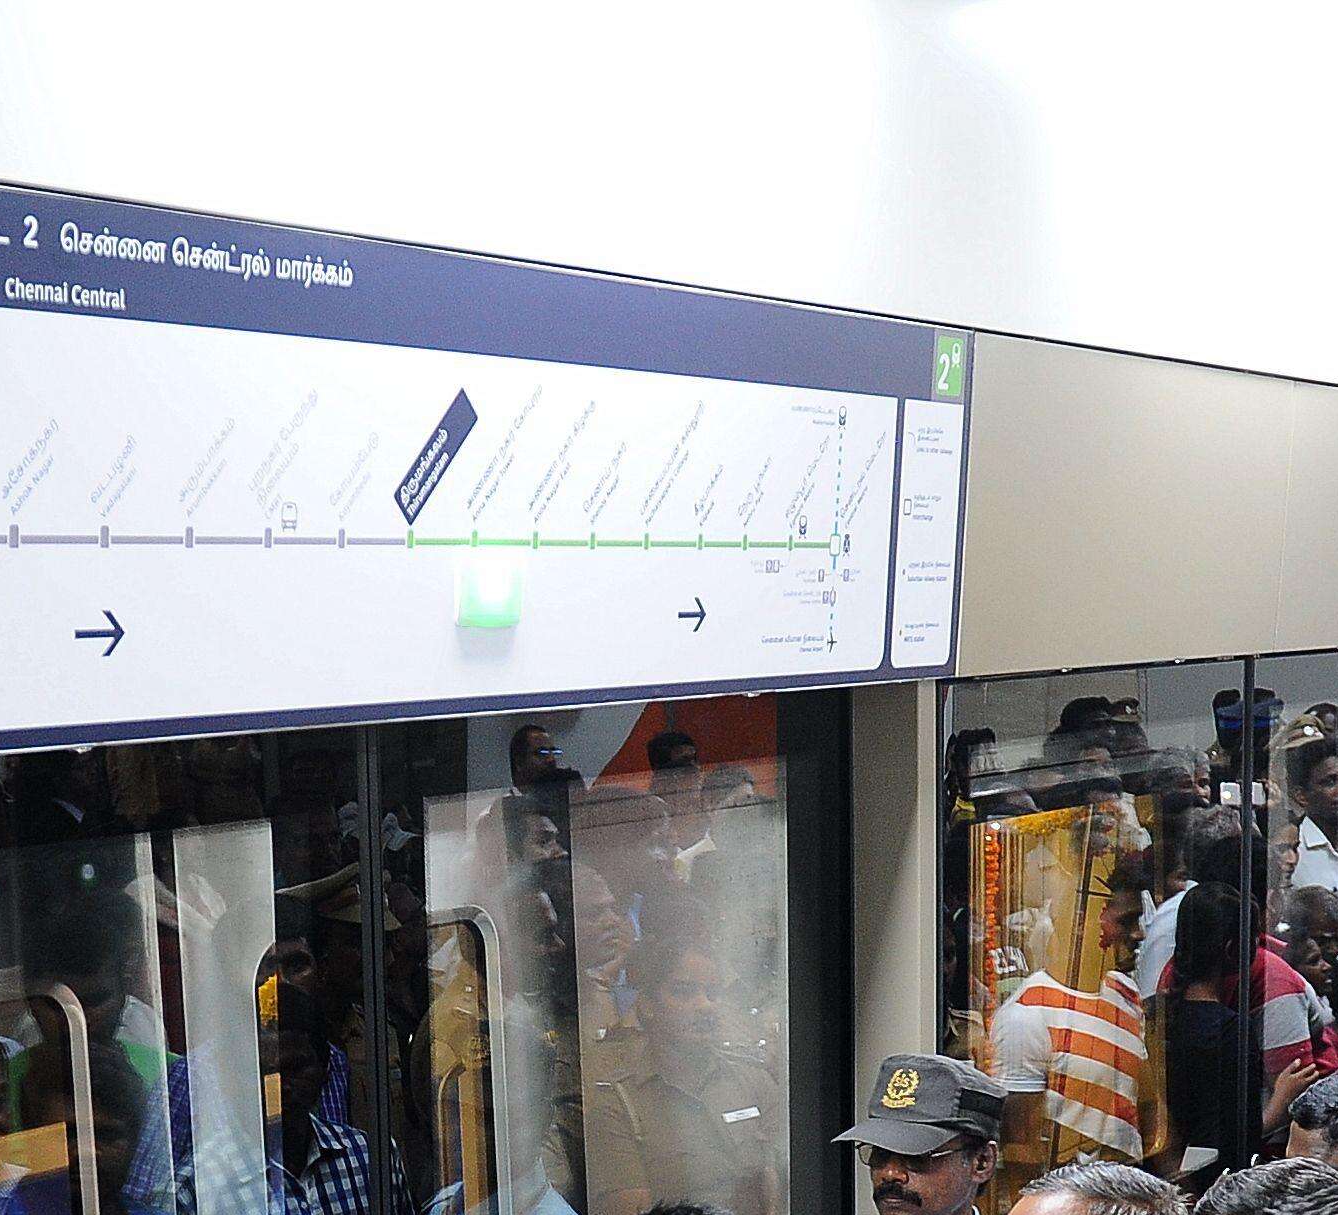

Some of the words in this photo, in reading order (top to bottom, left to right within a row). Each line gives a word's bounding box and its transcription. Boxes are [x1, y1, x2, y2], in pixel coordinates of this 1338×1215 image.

[23, 214, 39, 249] 2
[60, 220, 166, 263] சென்னை
[172, 236, 271, 282] சென்ட்ரல்
[275, 255, 354, 289] மார்க்கம்
[5, 276, 68, 304] Chennai
[71, 283, 126, 310] Central
[938, 353, 951, 391] 2
